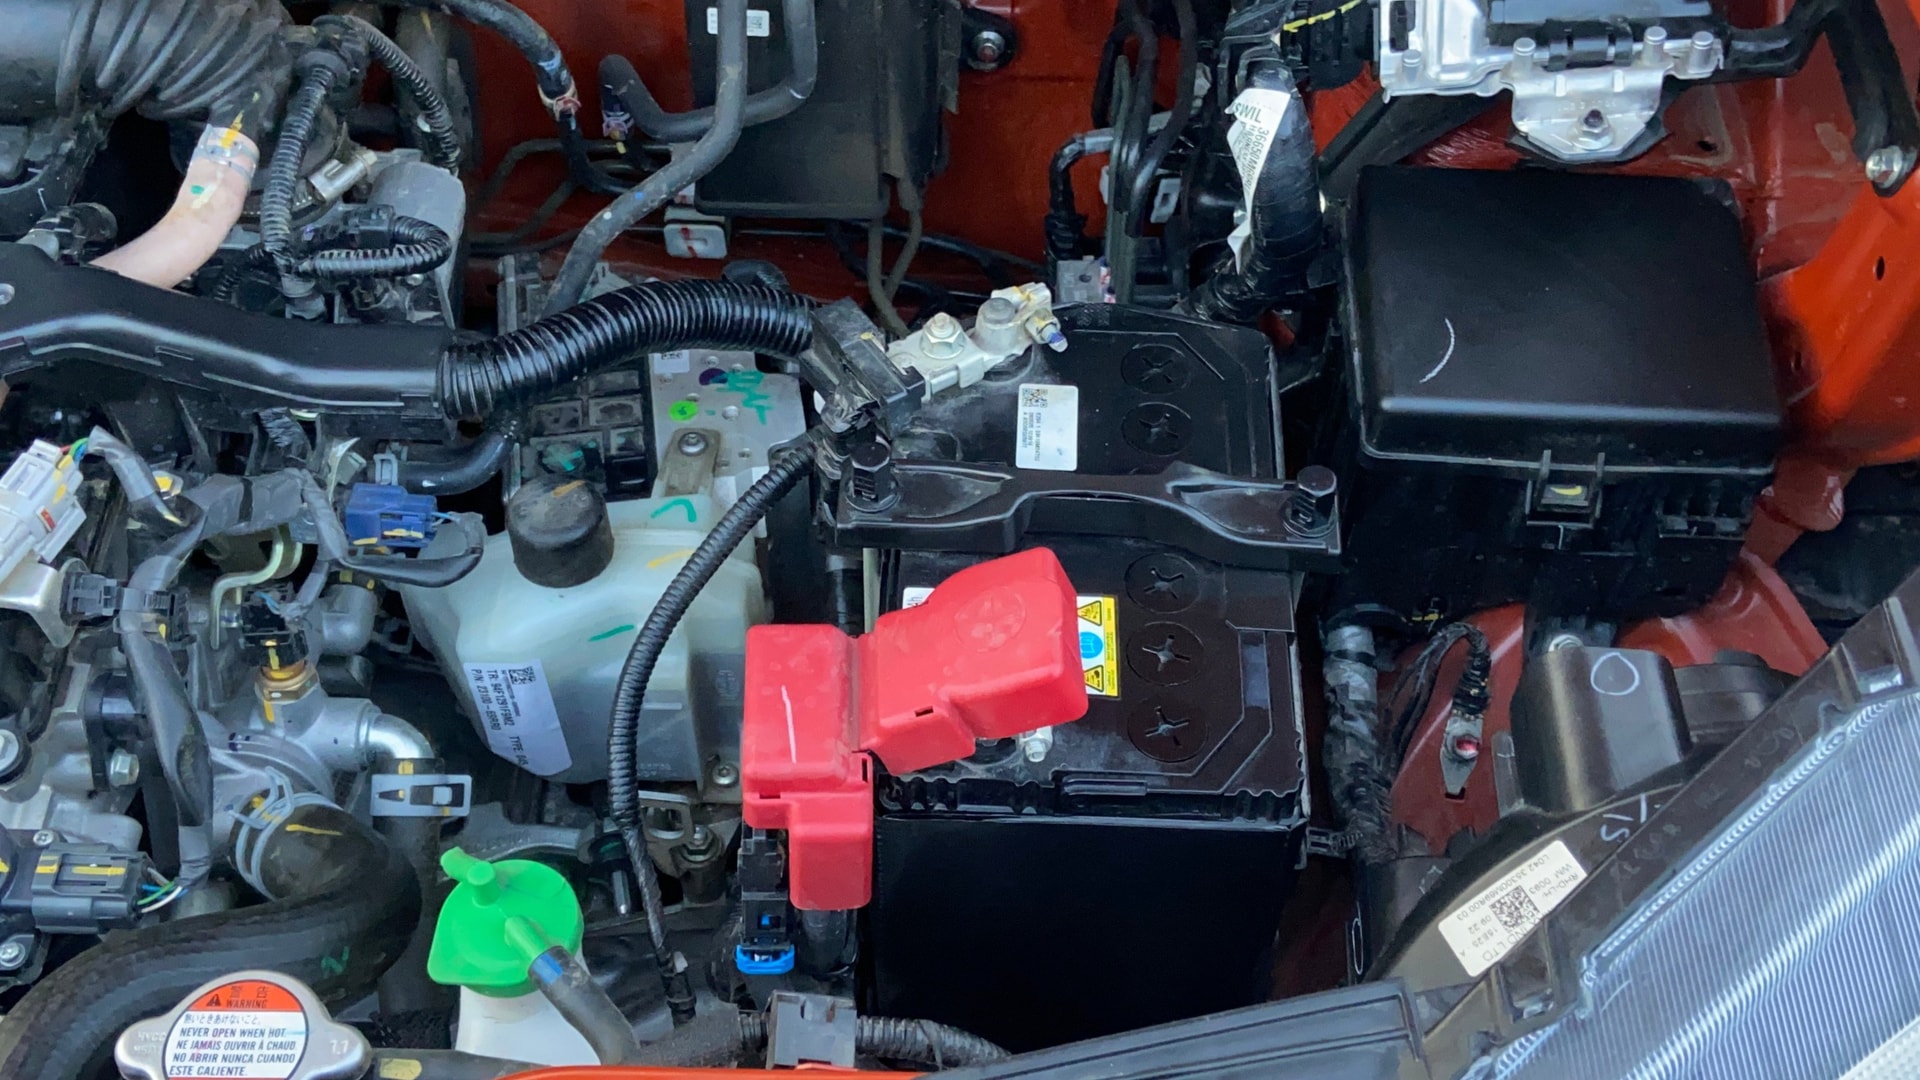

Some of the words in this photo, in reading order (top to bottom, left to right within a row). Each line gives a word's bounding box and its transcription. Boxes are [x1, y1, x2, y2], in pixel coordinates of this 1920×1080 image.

[226, 999, 268, 1009] WARNING
[180, 1027, 209, 1038] NEVER
[212, 1028, 237, 1038] OPEN
[239, 1028, 265, 1038] WHEN
[176, 1040, 188, 1050] NE
[190, 1040, 222, 1051] JAMAIS
[224, 1041, 257, 1051] OUVRIR
[266, 1041, 296, 1051] CHAUD
[172, 1053, 187, 1063] NO
[189, 1053, 218, 1063] ABRIR
[221, 1054, 254, 1064] NUNCA
[256, 1053, 296, 1064] CUANDO
[169, 1065, 194, 1076] ESTE
